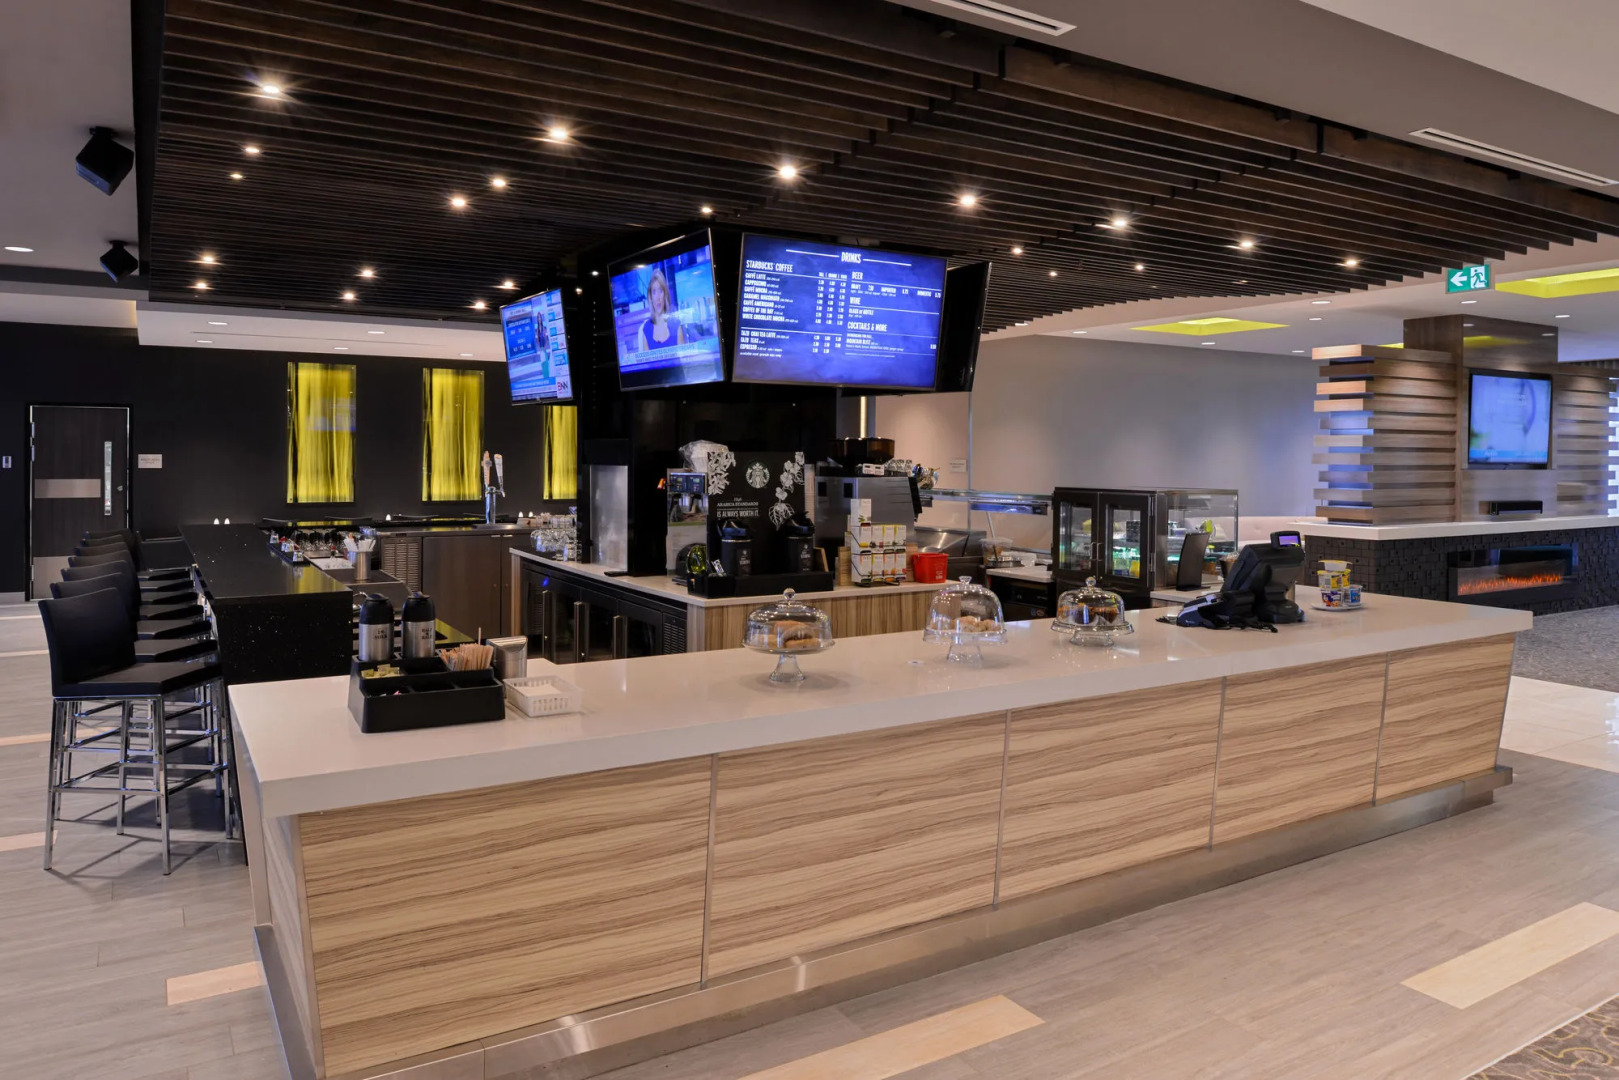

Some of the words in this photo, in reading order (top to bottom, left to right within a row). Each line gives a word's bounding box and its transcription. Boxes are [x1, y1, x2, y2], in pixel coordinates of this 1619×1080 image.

[841, 252, 861, 264] DRINKS
[776, 263, 793, 272] COFFEE
[852, 272, 863, 280] BEER
[850, 297, 861, 305] WINE
[848, 321, 870, 330] COCKTAILS
